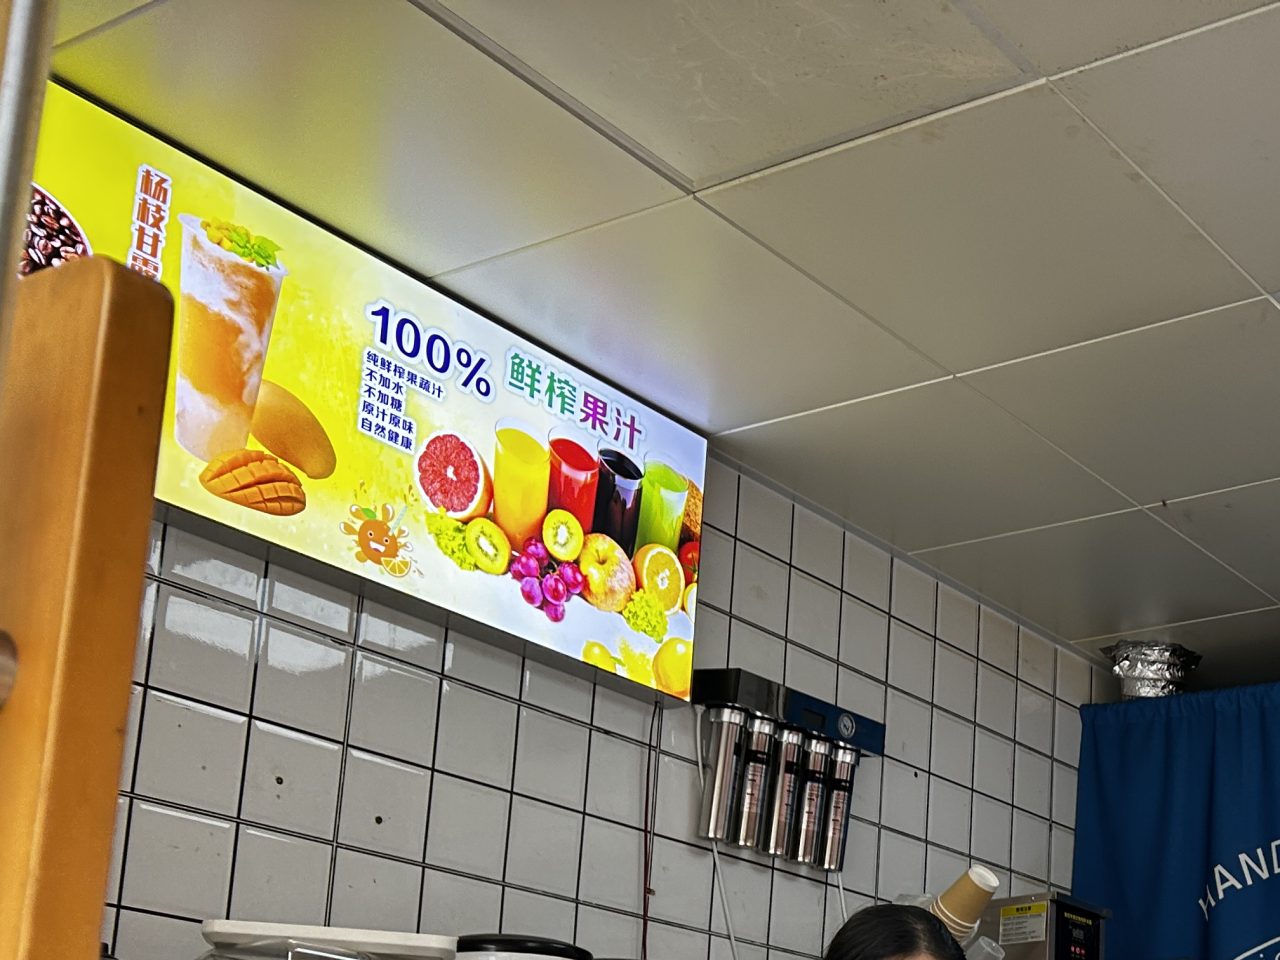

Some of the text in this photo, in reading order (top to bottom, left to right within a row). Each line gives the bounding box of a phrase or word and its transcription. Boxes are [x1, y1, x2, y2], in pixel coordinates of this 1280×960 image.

[370, 305, 491, 398] 100%
[364, 366, 405, 395] 不加水
[365, 350, 444, 399] 纯鲜榨果蔬汁
[362, 383, 403, 412] 不加糖
[509, 352, 642, 450] 鲜榨果汁
[360, 417, 413, 451] 自然健康
[361, 400, 414, 435] 原汁原味
